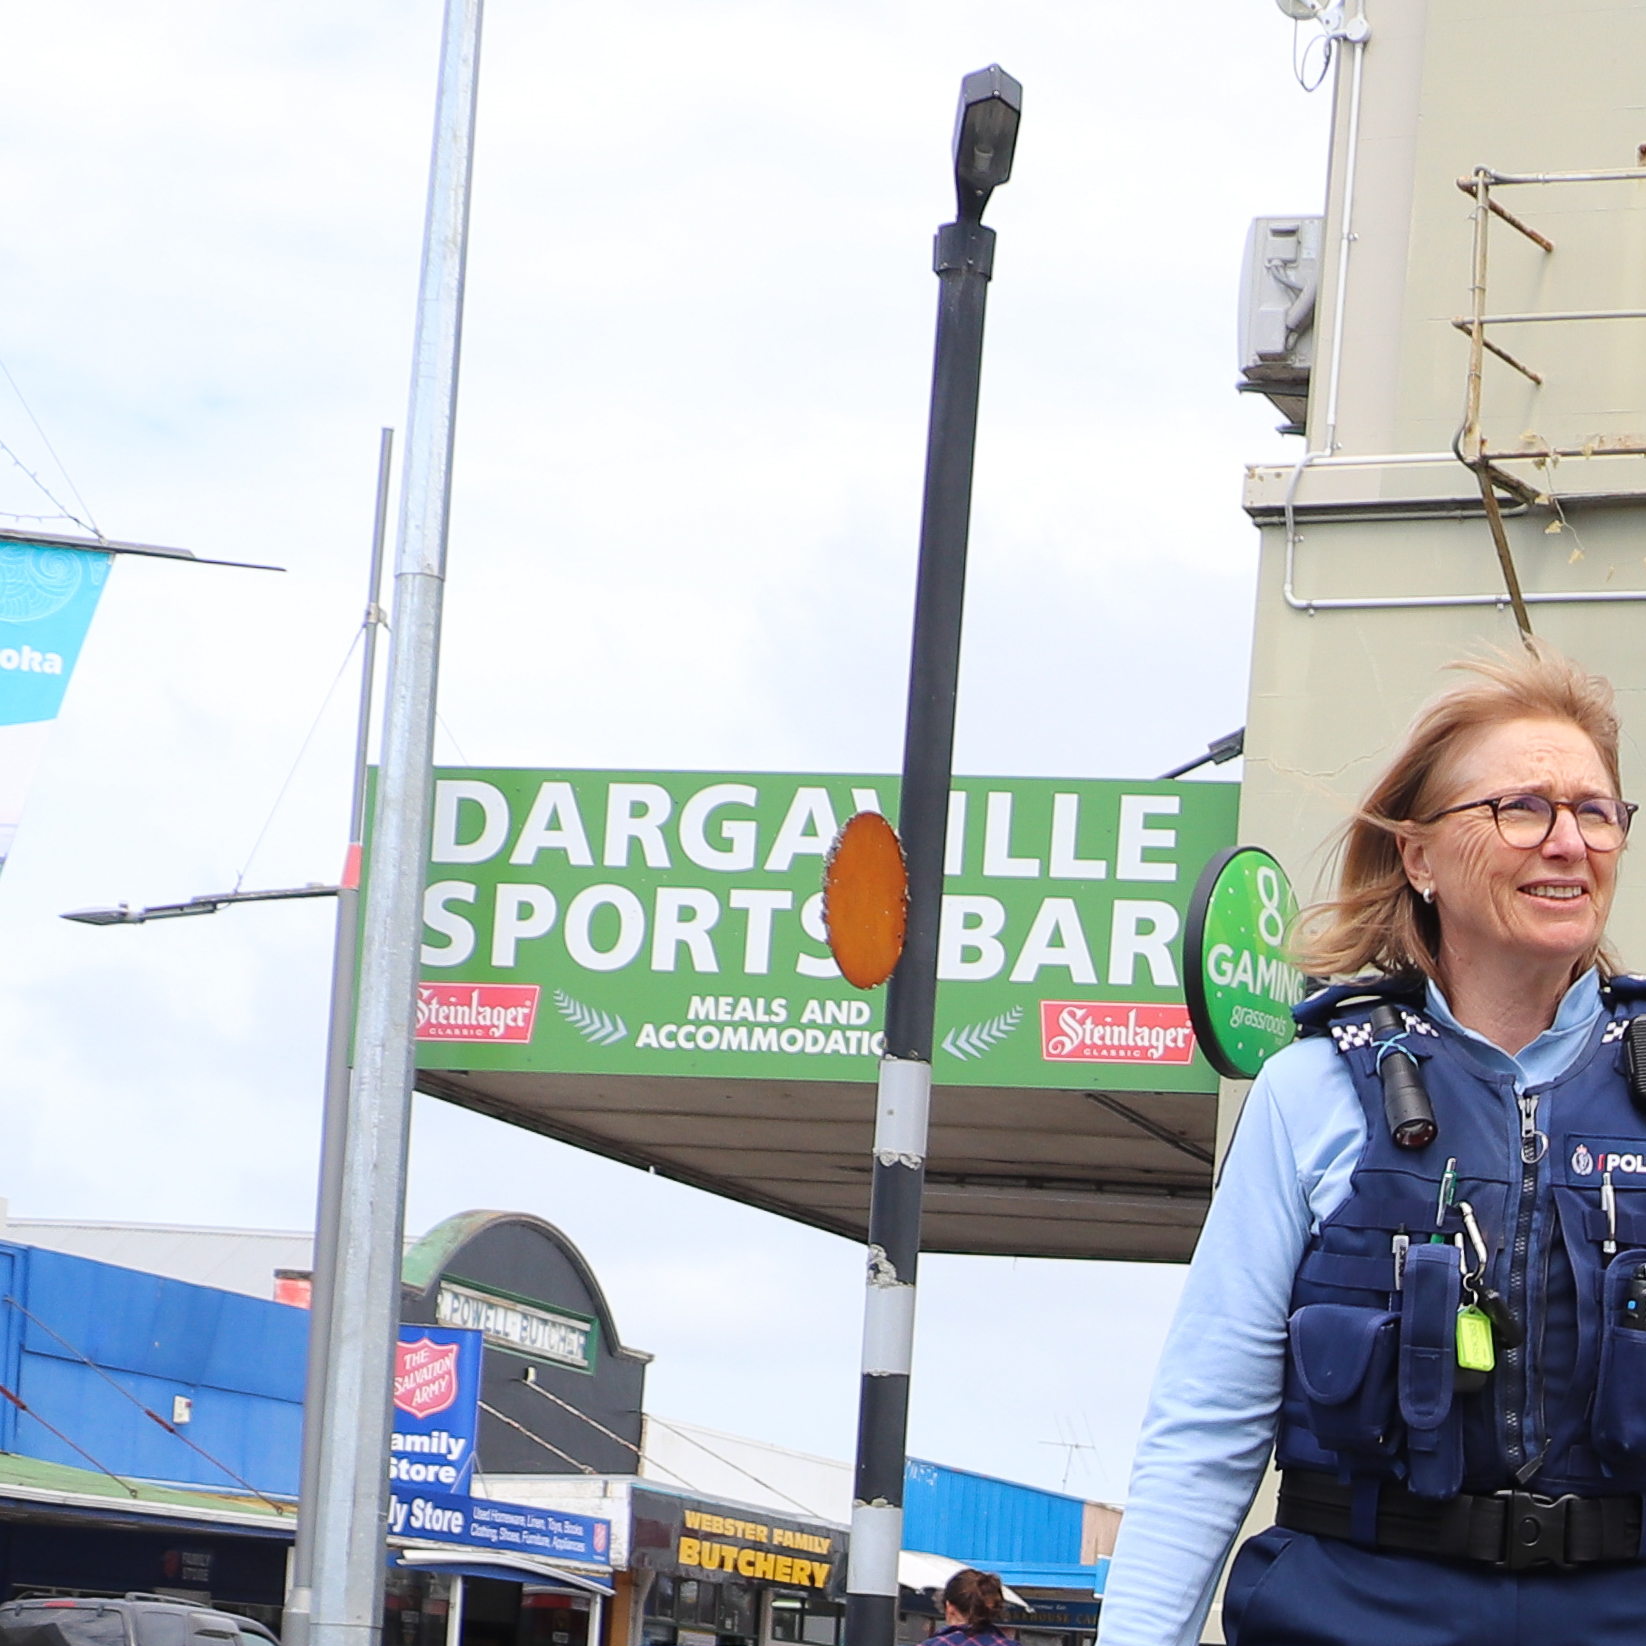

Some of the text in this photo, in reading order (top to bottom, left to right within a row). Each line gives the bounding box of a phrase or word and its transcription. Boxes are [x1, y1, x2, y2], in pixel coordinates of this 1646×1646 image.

[937, 893, 1180, 987] BAR
[1207, 943, 1304, 1007] GAMING
[688, 995, 871, 1027] MEALS AND
[429, 1027, 484, 1036] CLASSIC
[635, 1022, 886, 1057] ACCOMMODATIO
[1048, 1006, 1192, 1059] Steinlager
[1084, 1048, 1141, 1057] CLASSIC
[450, 1292, 511, 1338] POWELL
[394, 1352, 454, 1396] SALVATION
[403, 1348, 430, 1371] THE
[411, 1374, 451, 1407] ARMY
[391, 1431, 466, 1461] amily
[410, 1498, 464, 1534] Store
[684, 1509, 832, 1555] WEBSTER FAMILY
[678, 1536, 832, 1589] BUTCHERY
